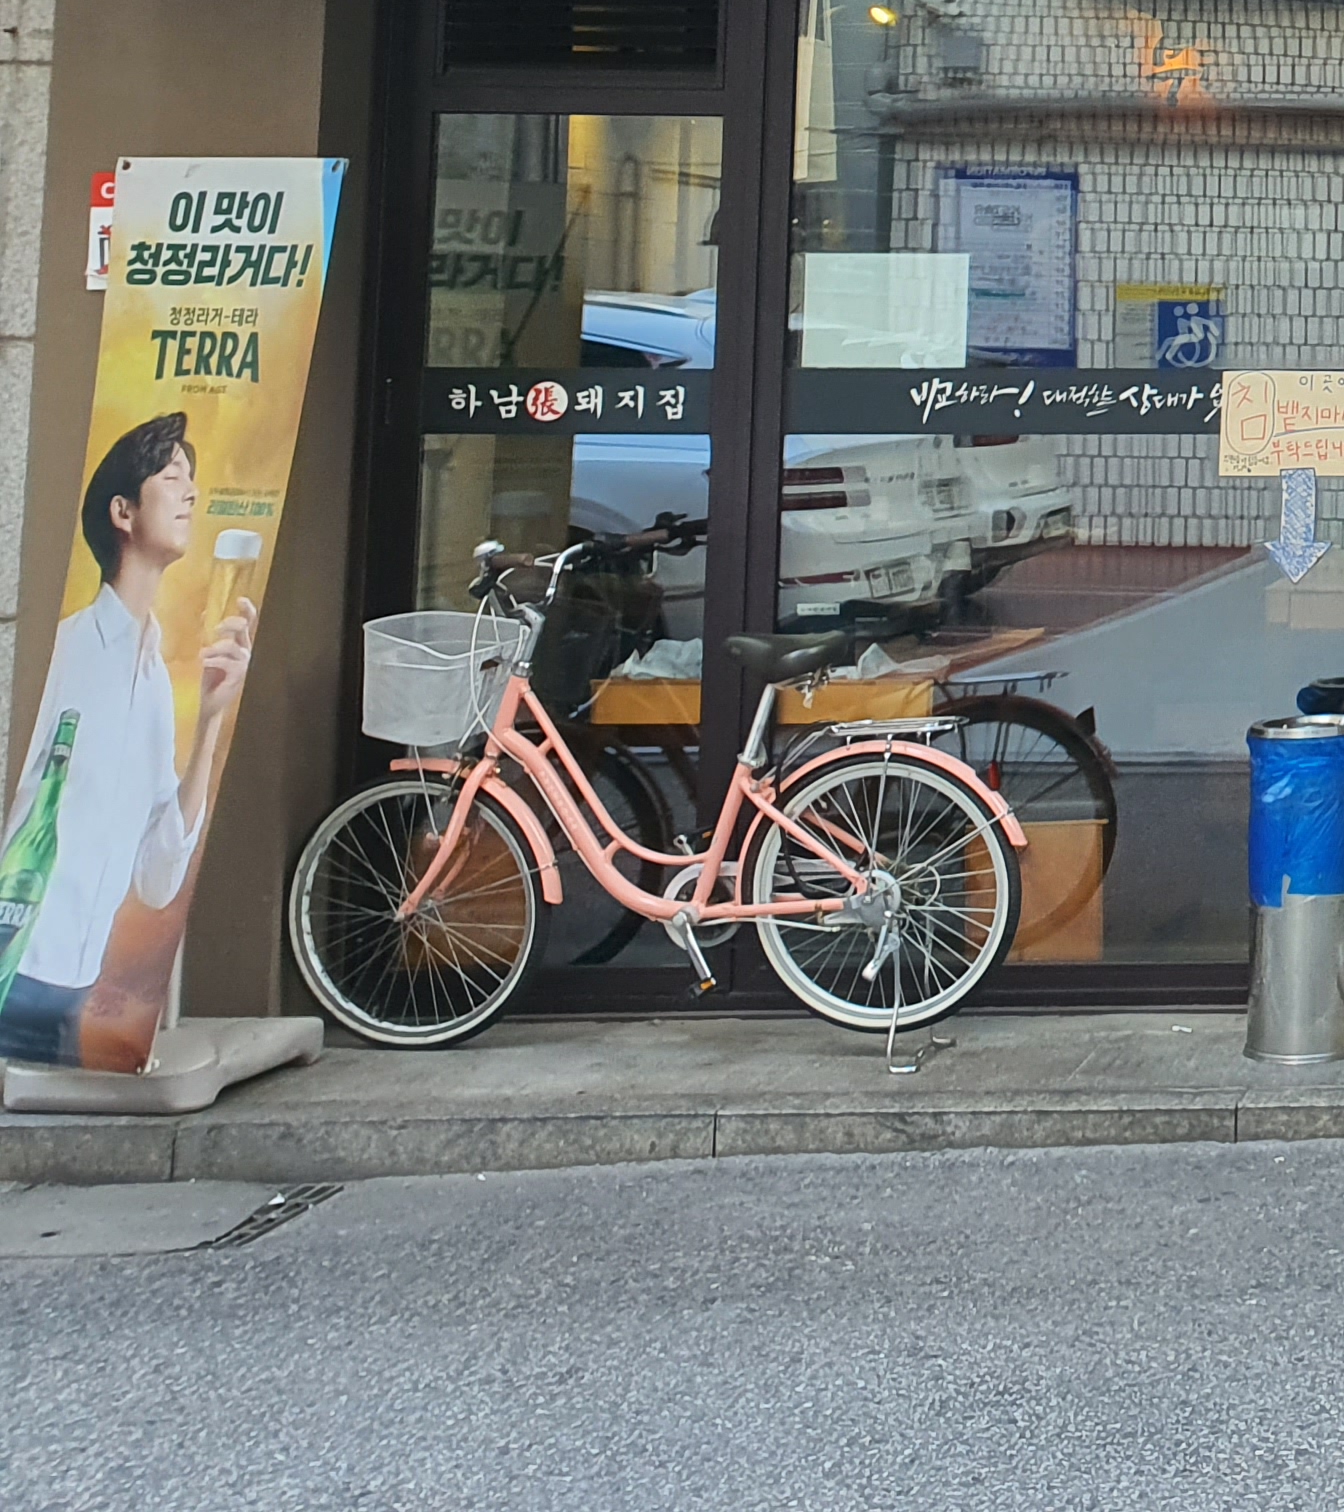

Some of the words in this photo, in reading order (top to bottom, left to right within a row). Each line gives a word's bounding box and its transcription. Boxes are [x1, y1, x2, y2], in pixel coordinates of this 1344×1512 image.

[169, 191, 207, 234] 이
[212, 190, 285, 236] 맛이
[126, 240, 314, 289] 청정라거다!
[169, 307, 260, 328] 청정라거-테라
[151, 329, 260, 384] TERRA
[1231, 380, 1269, 441] 침
